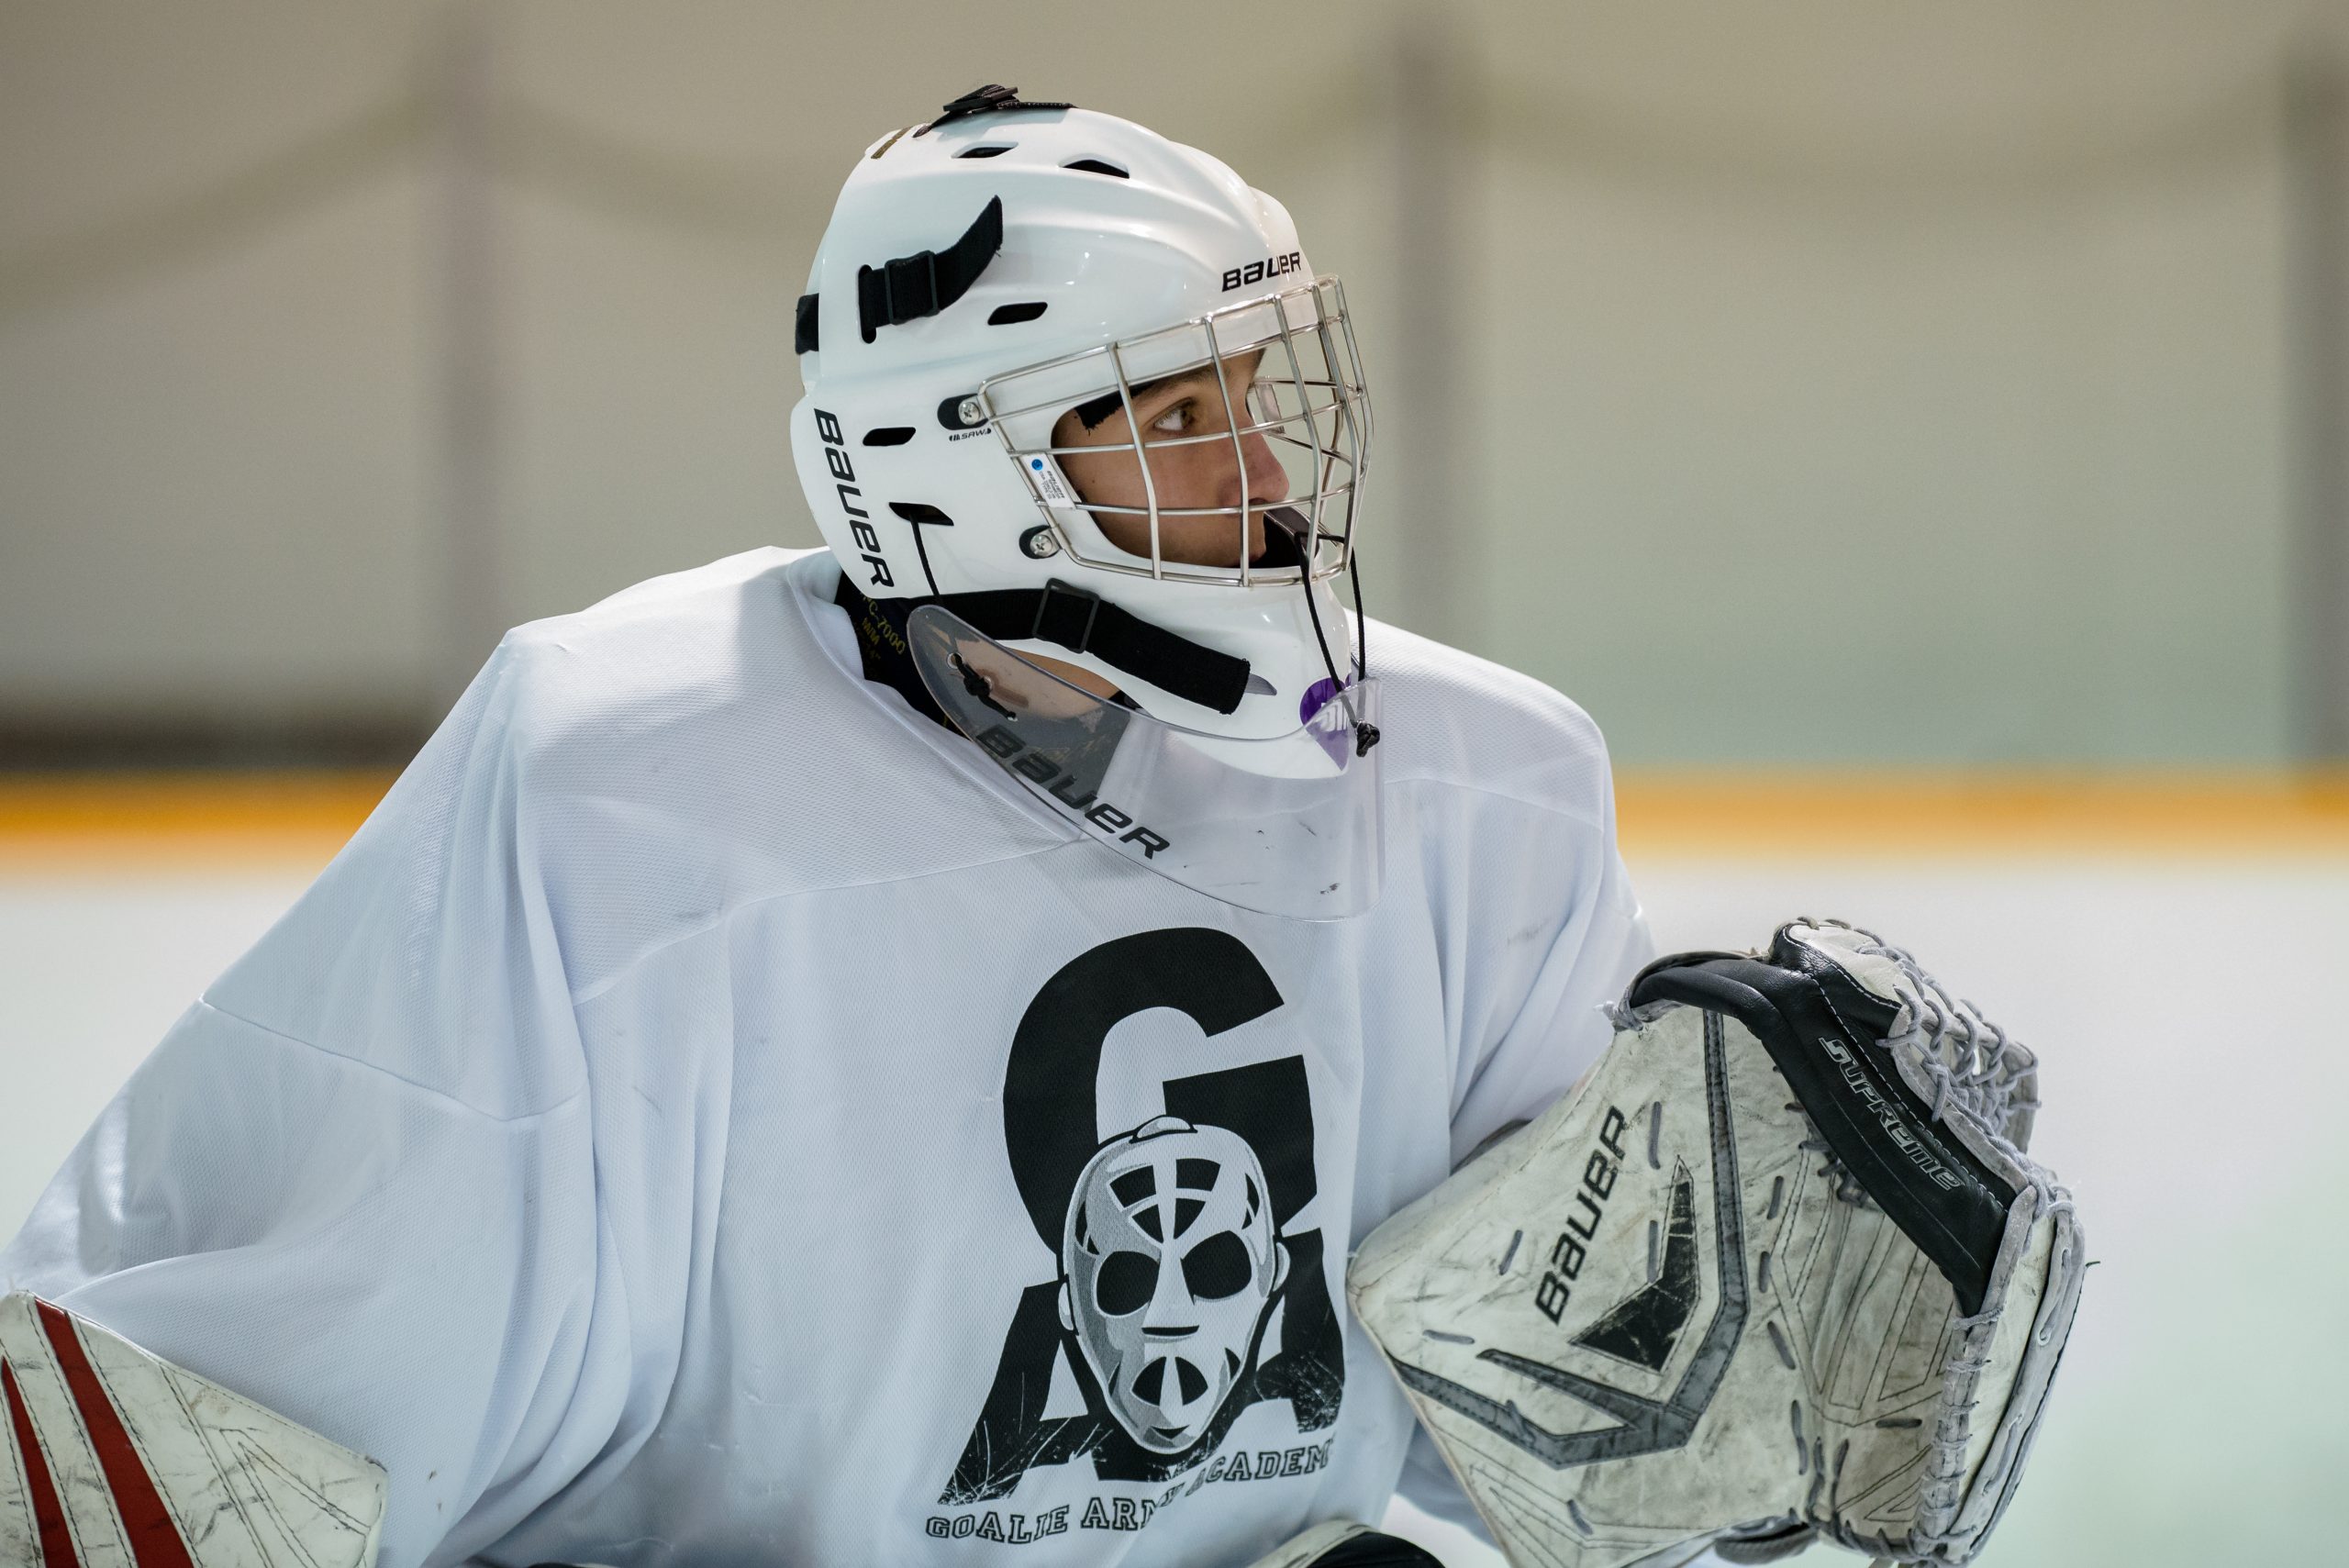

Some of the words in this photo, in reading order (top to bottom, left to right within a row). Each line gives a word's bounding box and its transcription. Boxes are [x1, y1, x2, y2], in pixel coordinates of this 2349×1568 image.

[1221, 251, 1302, 293] BAUER
[814, 408, 895, 588] BAUER
[975, 723, 1171, 861] BAUER
[1818, 1037, 1965, 1191] SUPREME
[1534, 1105, 1626, 1327] BAUER
[925, 1504, 1070, 1545] GOALIE
[1185, 1437, 1335, 1497] ACADEM
